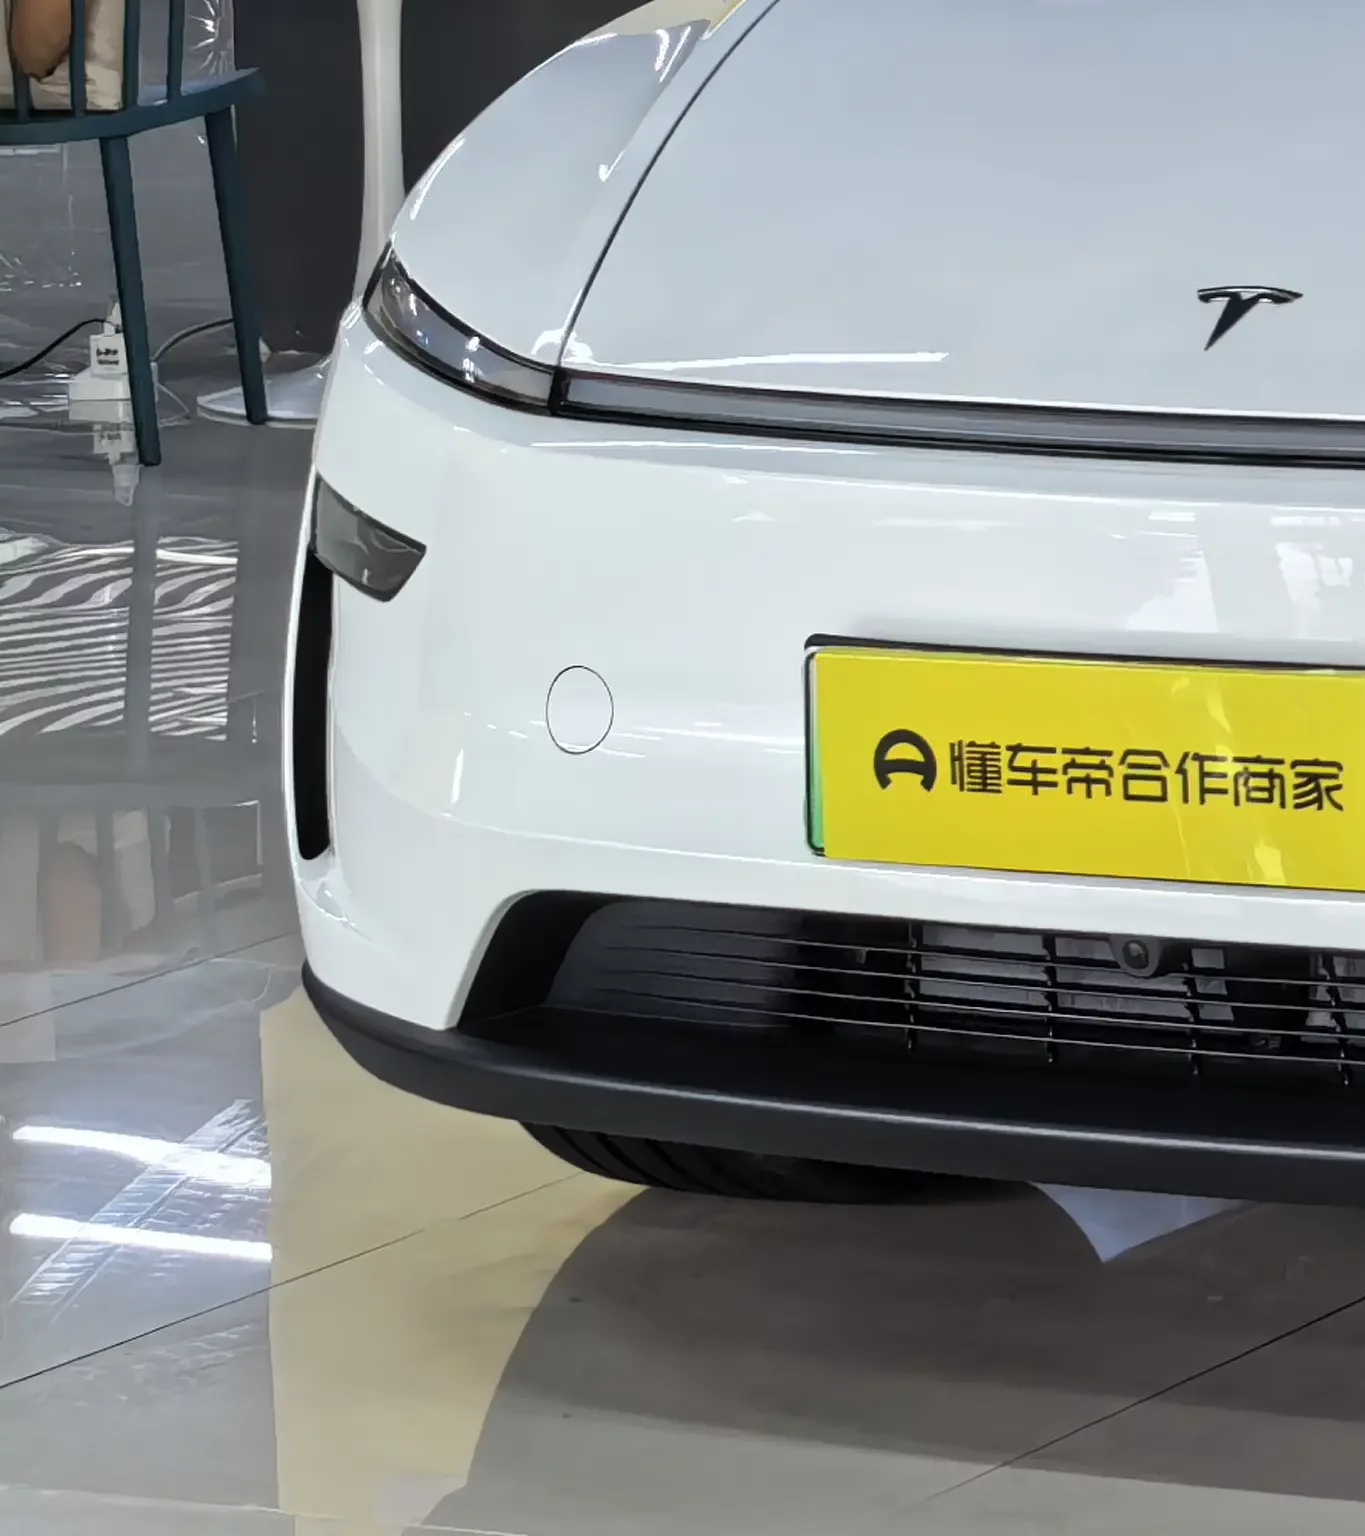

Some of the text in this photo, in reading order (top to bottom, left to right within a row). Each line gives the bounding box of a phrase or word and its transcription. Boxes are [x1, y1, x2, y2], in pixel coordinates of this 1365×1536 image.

[948, 738, 1345, 812] 懂车帝合作商家
